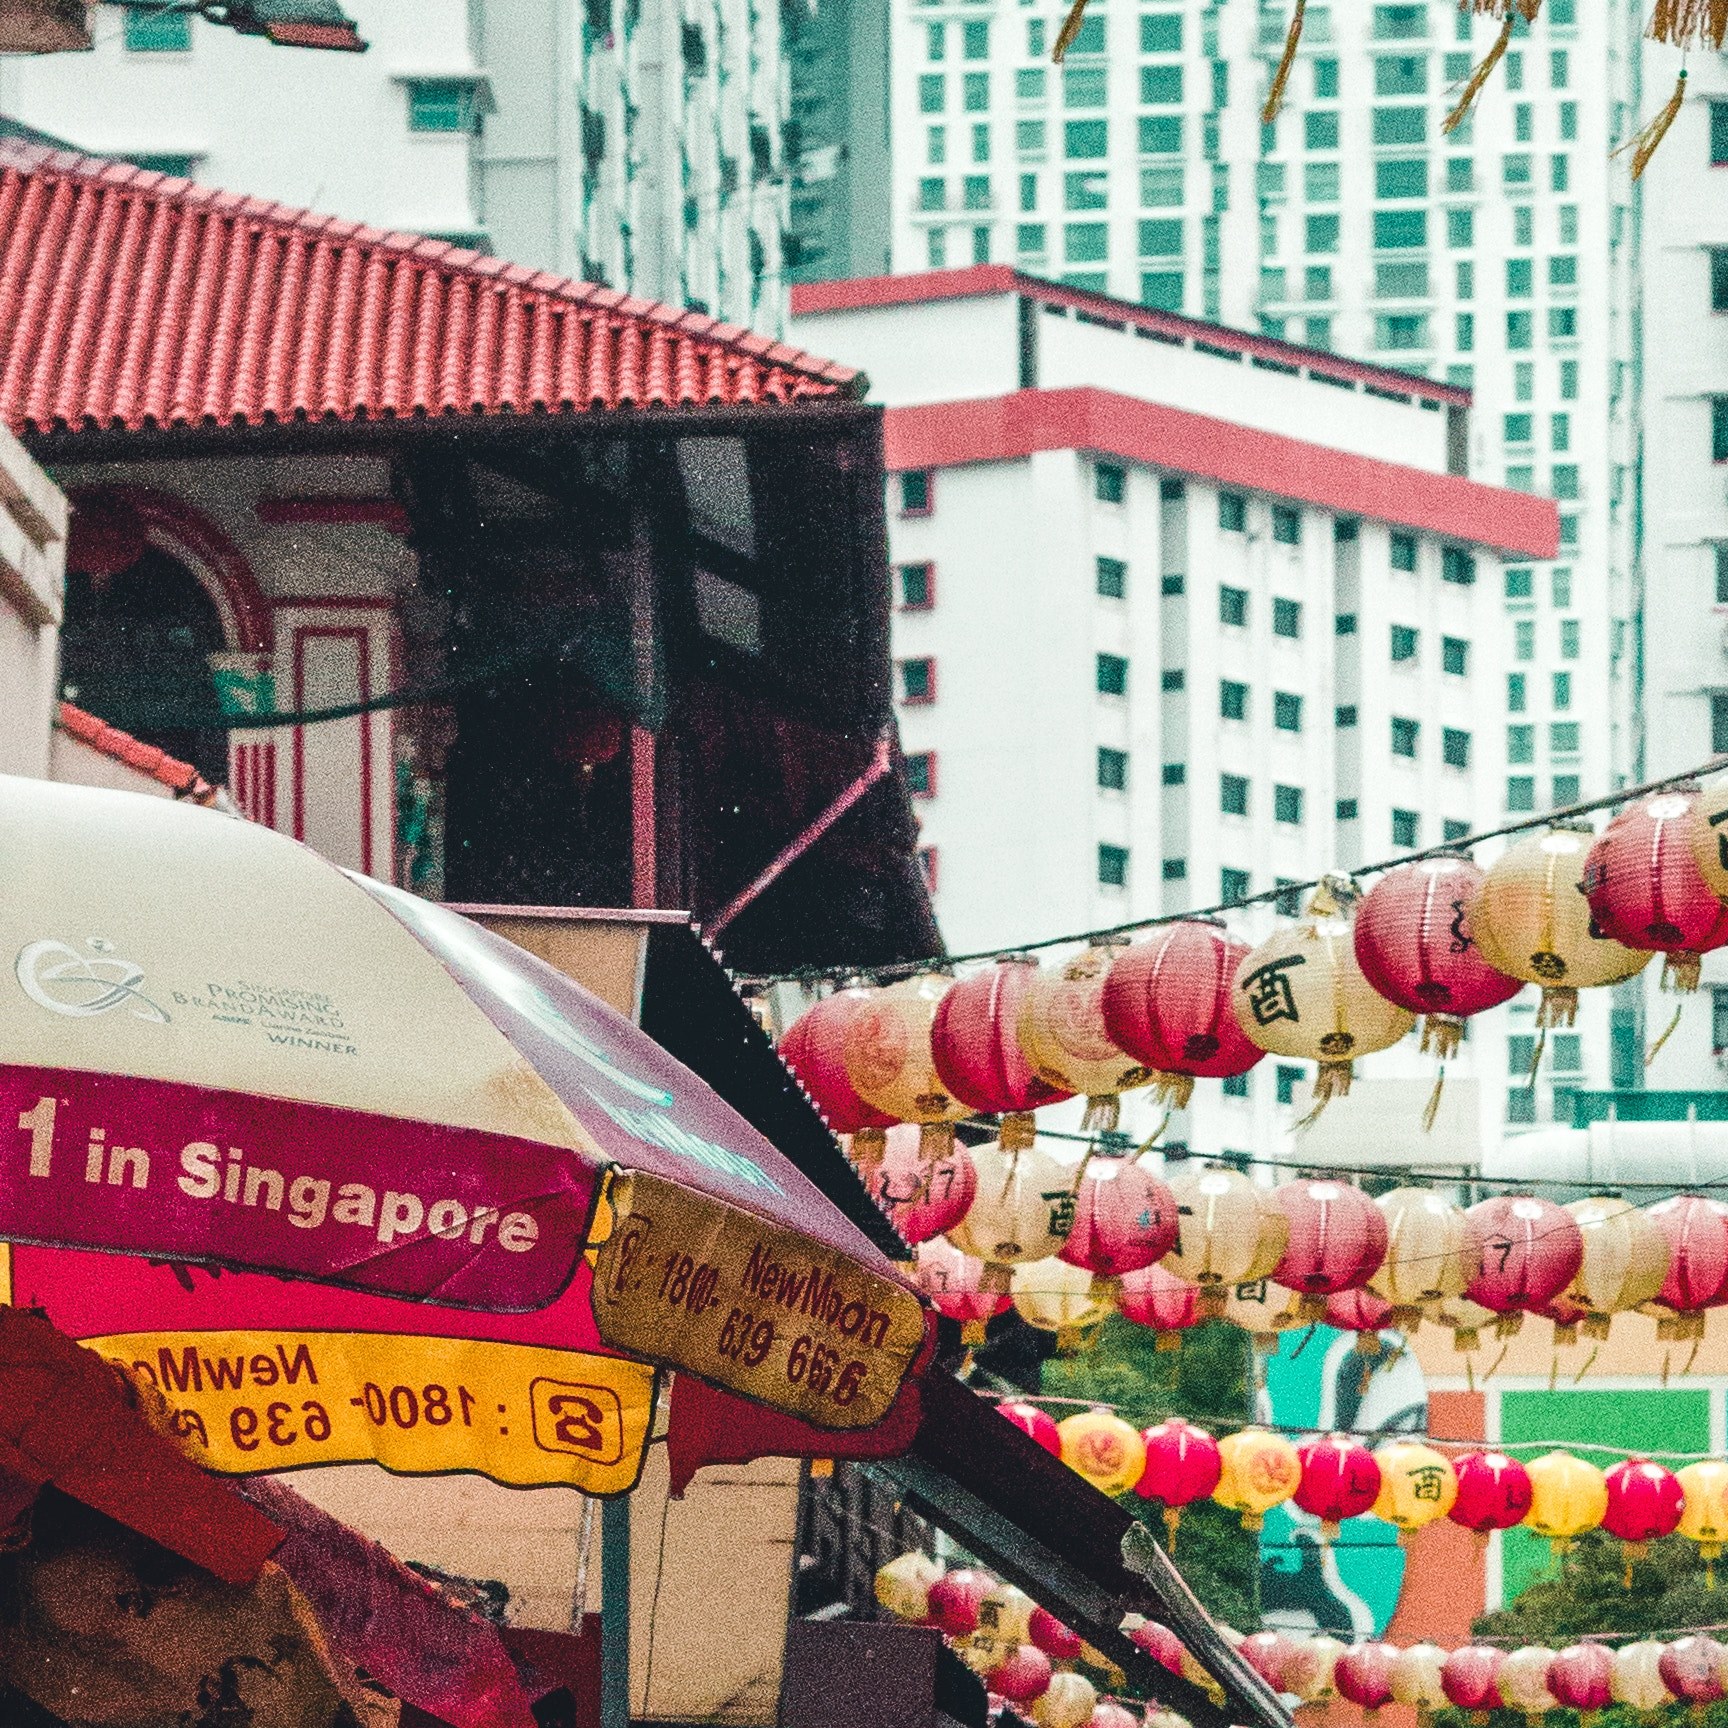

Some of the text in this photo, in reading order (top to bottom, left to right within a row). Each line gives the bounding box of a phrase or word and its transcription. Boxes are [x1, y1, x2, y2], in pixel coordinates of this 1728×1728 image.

[1241, 954, 1306, 1026] 酉
[266, 1032, 358, 1056] WINNER
[86, 1128, 151, 1189] in
[177, 1140, 540, 1253] Singapore
